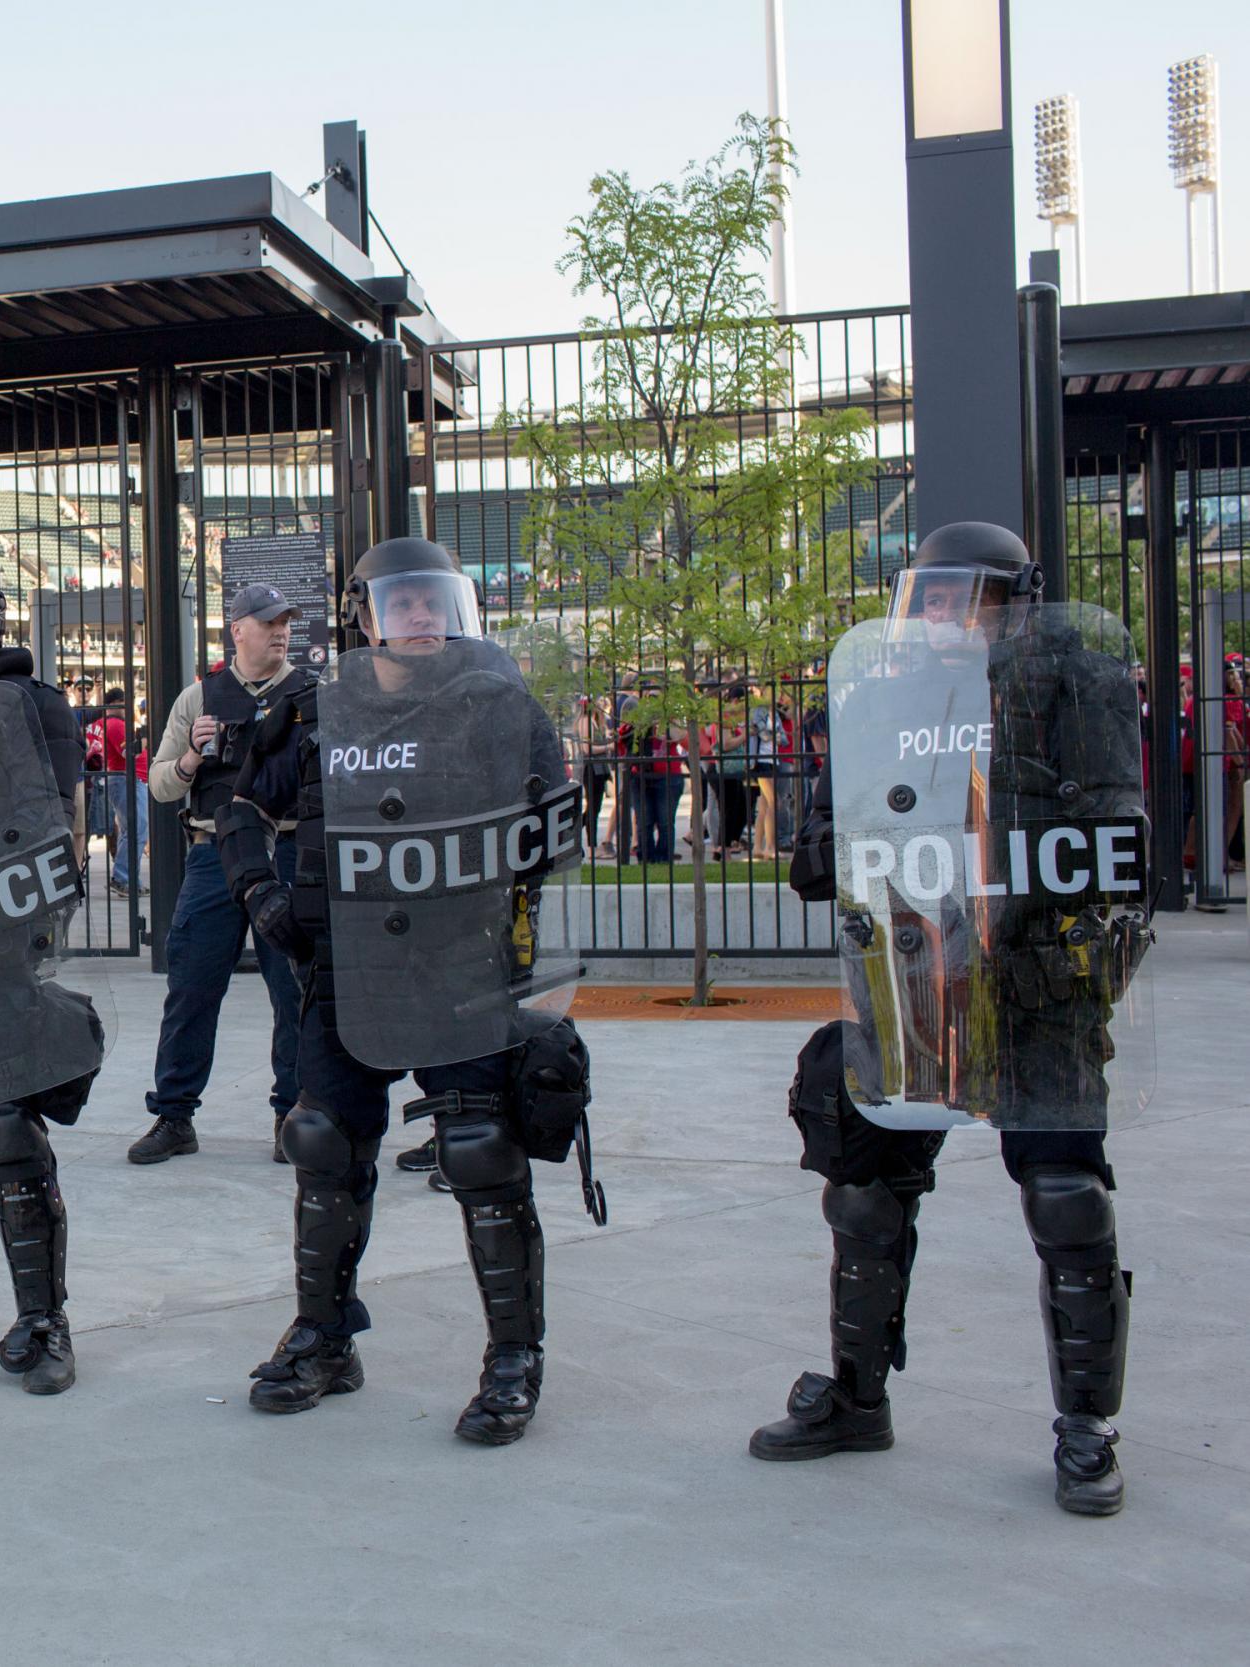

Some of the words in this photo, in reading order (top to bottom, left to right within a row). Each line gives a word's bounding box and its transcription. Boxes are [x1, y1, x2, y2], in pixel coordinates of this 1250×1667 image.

[329, 742, 418, 775] POLICE
[898, 723, 995, 760] POLICE
[338, 796, 575, 893] POLICE
[850, 825, 1141, 904] POLICE
